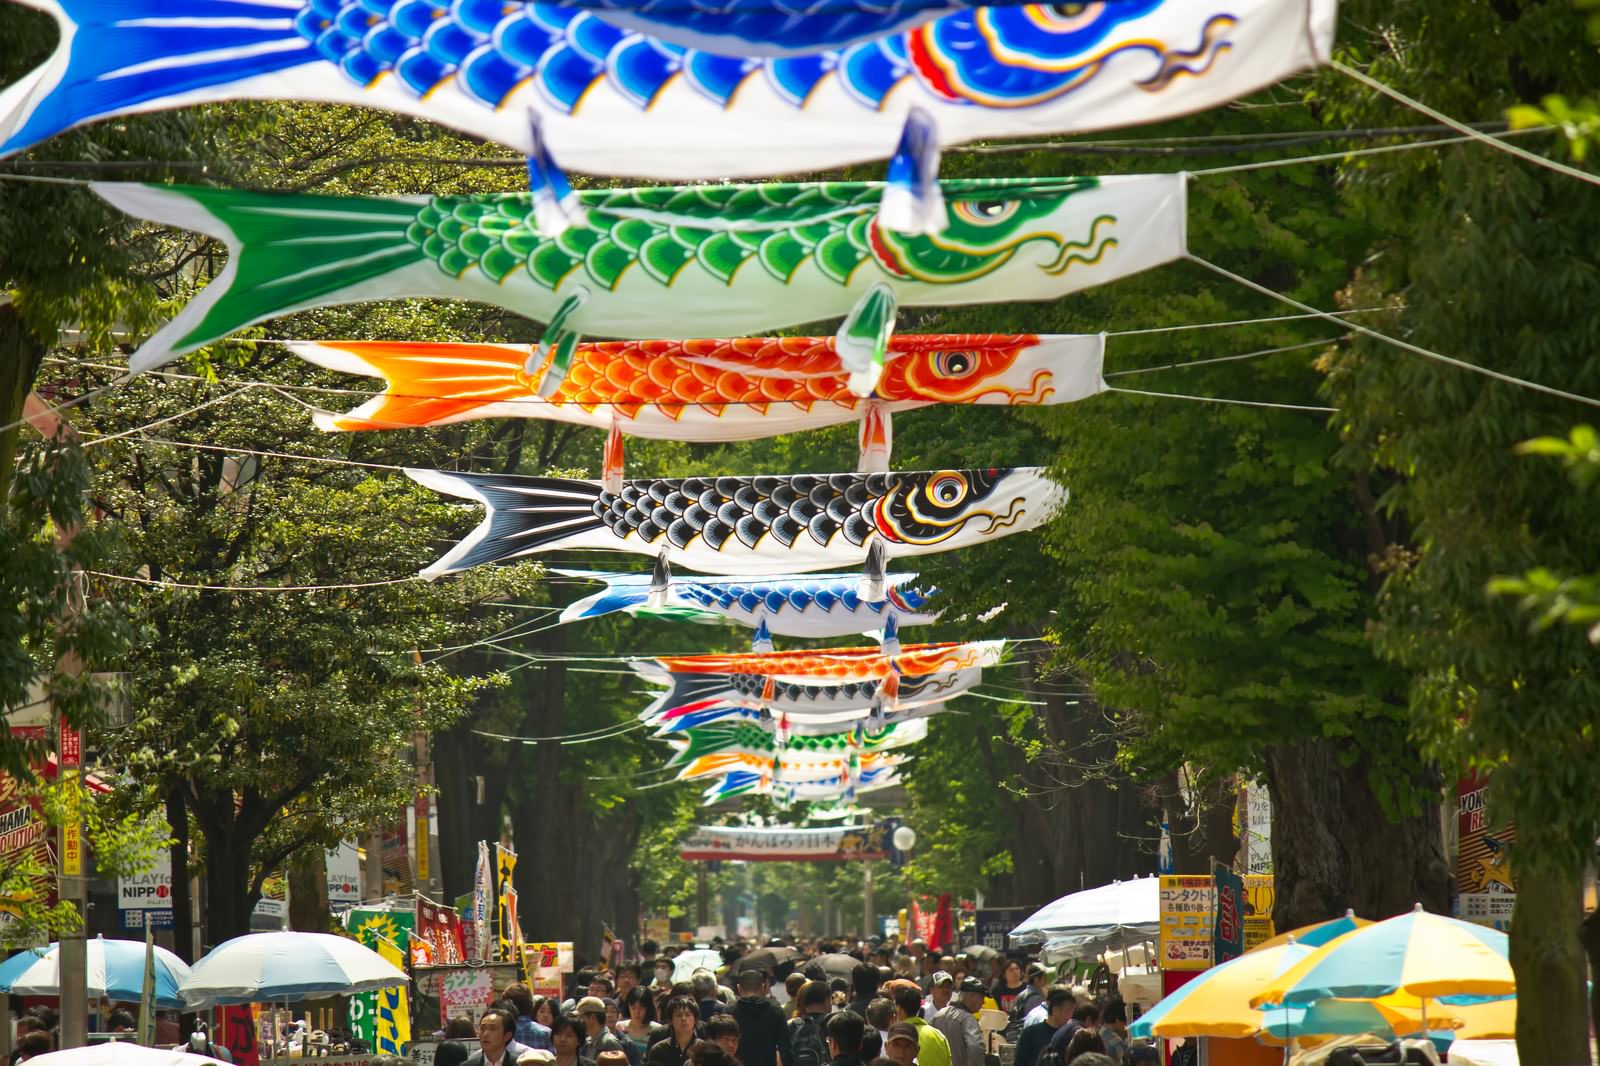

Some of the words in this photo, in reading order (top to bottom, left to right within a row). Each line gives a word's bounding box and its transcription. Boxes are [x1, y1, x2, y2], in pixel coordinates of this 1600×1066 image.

[0, 806, 31, 833] HAMA
[1471, 811, 1487, 831] RE
[0, 821, 43, 852] OLUTION
[123, 873, 171, 884] PLAYfo
[1160, 889, 1217, 902] コンタクトレ
[445, 968, 477, 990] ランチ
